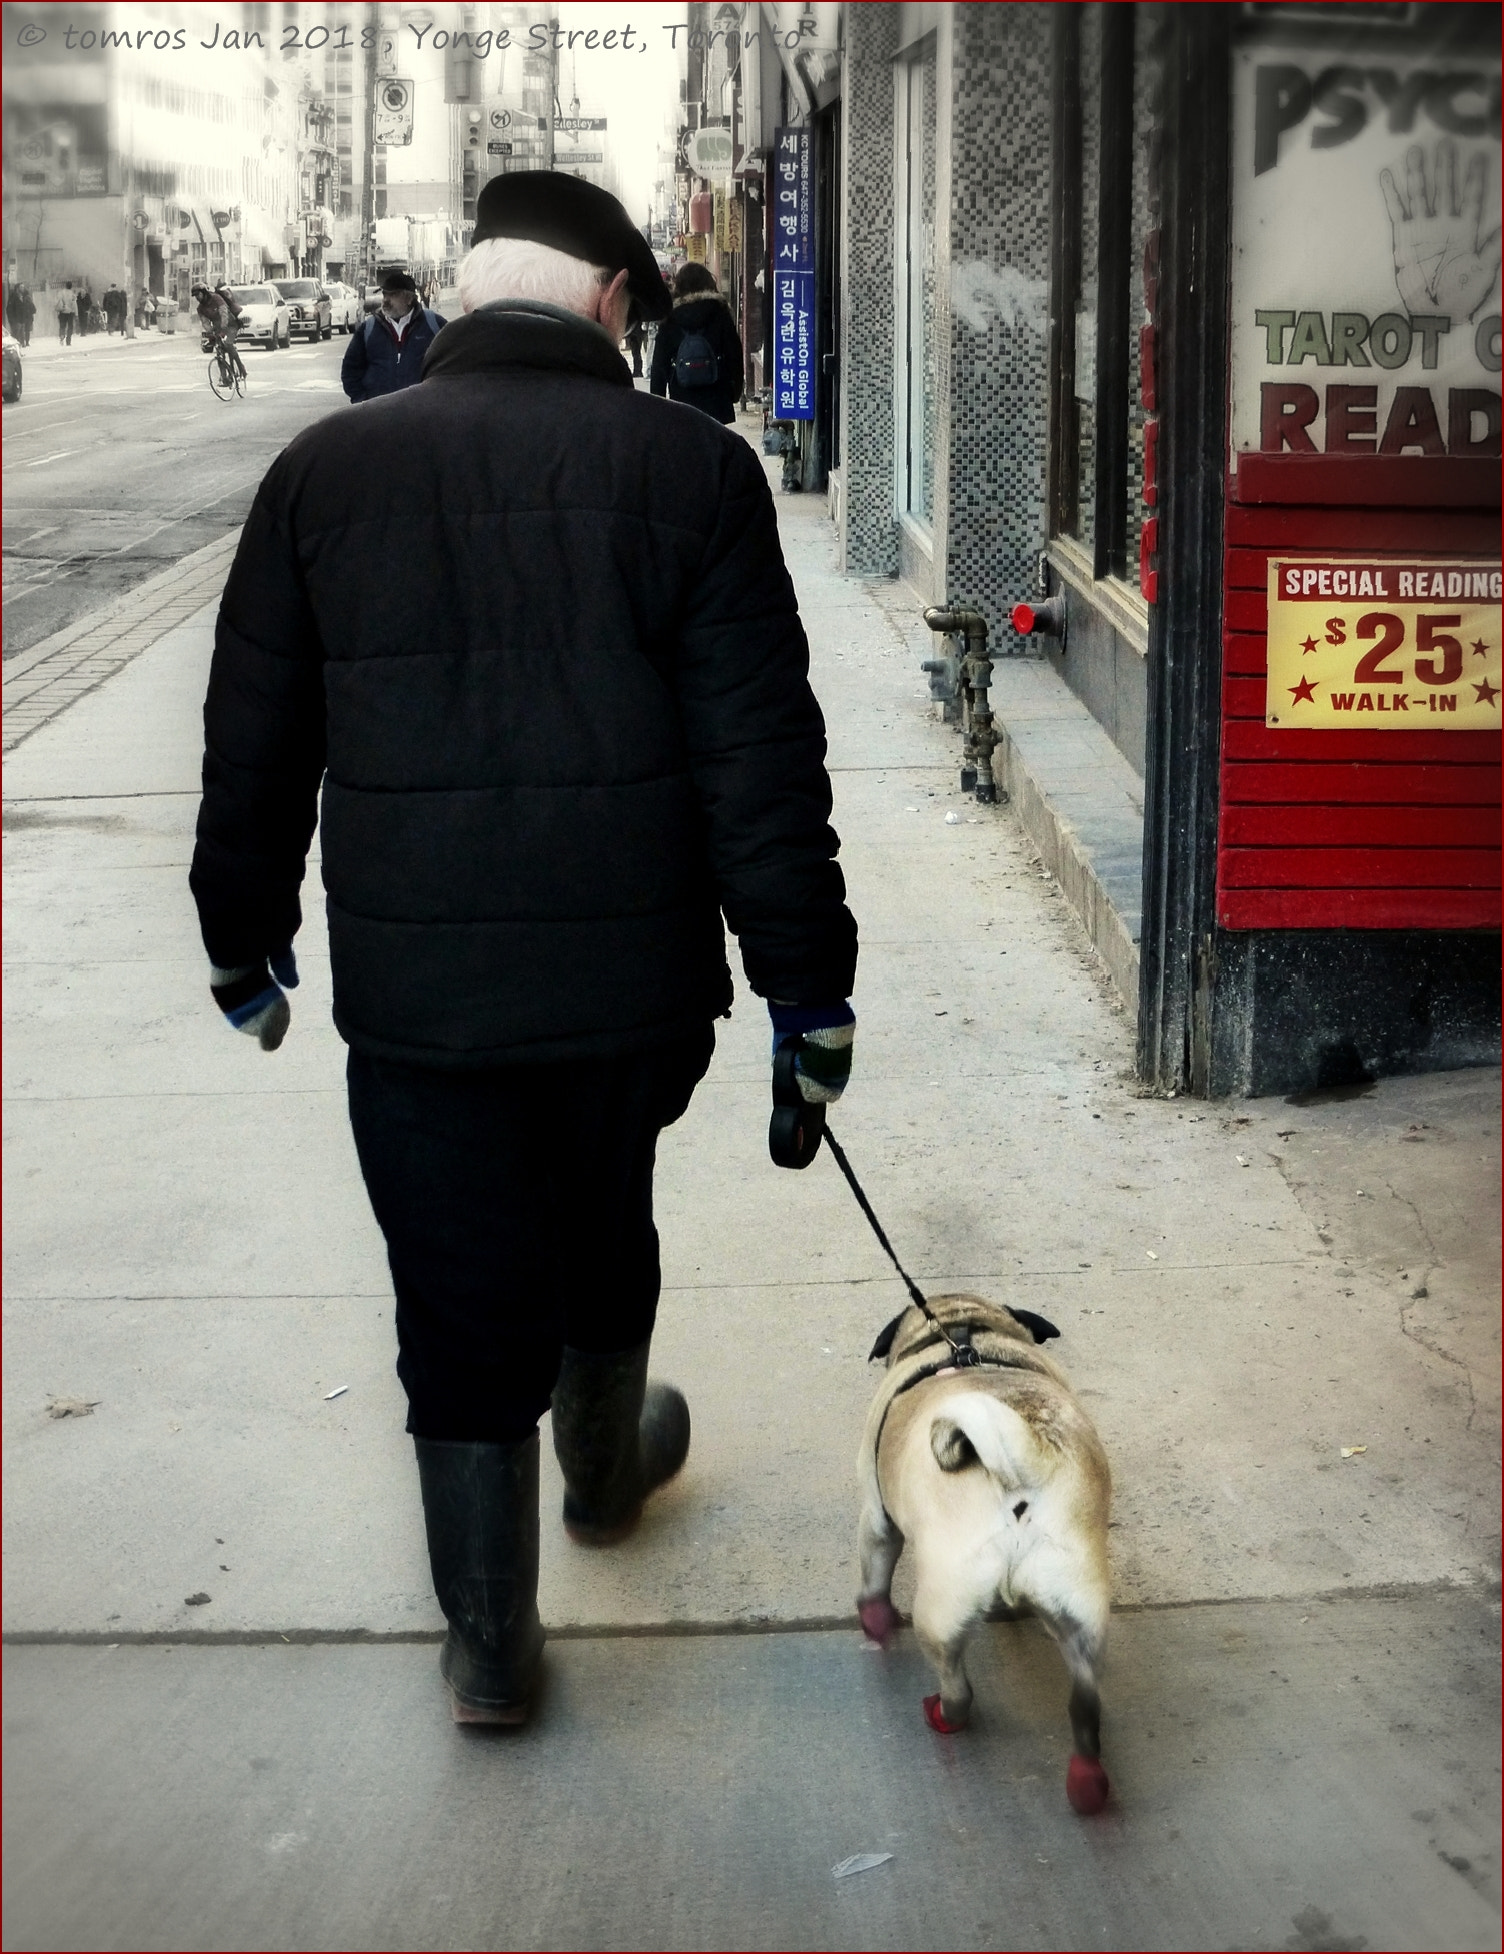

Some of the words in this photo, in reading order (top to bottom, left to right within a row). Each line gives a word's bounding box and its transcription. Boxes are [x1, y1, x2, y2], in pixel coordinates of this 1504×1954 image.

[553, 117, 593, 130] ellesley
[800, 134, 809, 148] KC
[1254, 64, 1501, 178] PSYC
[800, 149, 809, 179] TOURS
[779, 134, 799, 263] 세방여행사
[1255, 309, 1451, 371] TAROT
[798, 369, 809, 409] Global
[1259, 381, 1502, 458] READ
[1286, 569, 1389, 597] SPECIAL
[1399, 571, 1502, 599] READING
[1325, 612, 1464, 686] $25
[1331, 693, 1458, 712] WALK-IN
